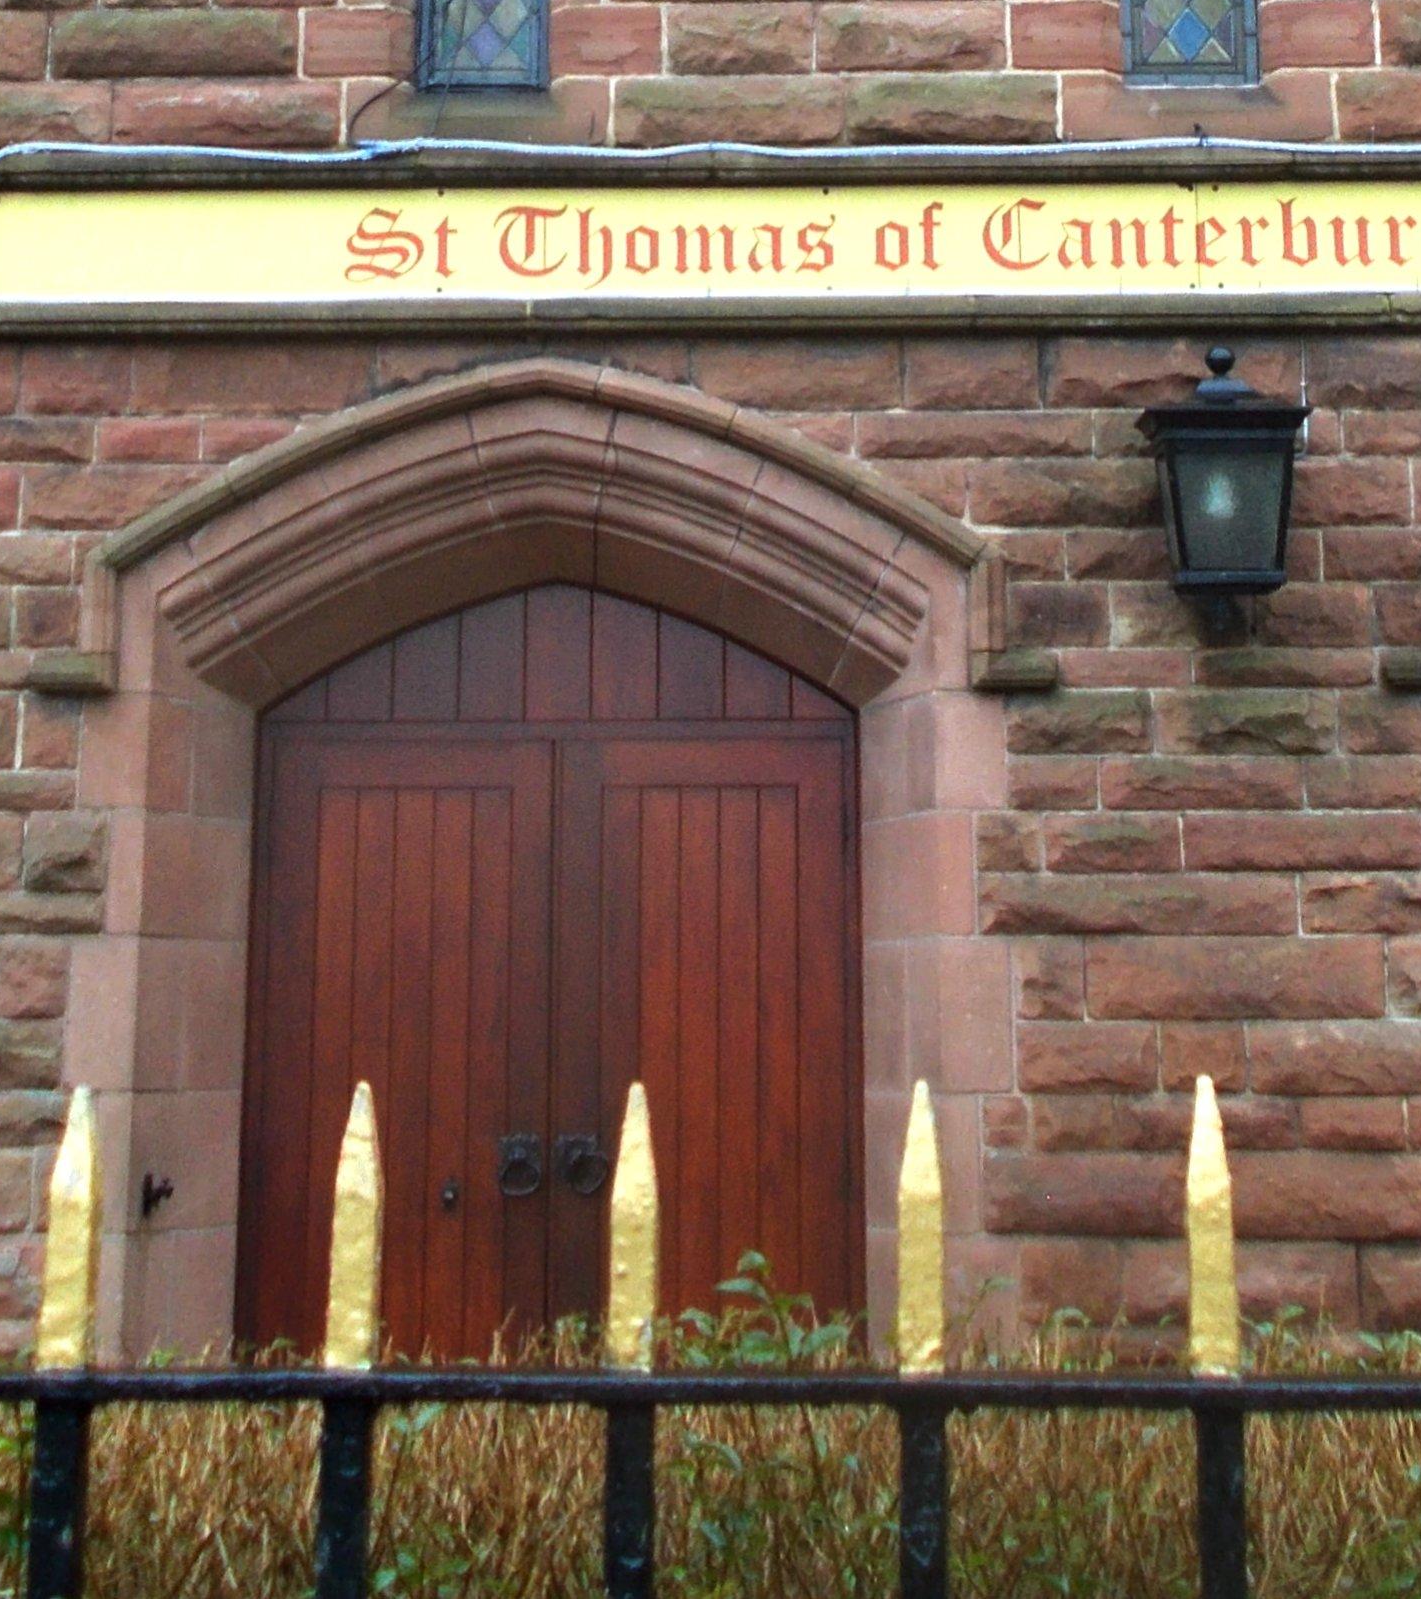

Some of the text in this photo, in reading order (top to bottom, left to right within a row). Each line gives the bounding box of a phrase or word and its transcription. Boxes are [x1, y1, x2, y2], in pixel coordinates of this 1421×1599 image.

[344, 206, 458, 283] St
[493, 204, 835, 290] Thomas
[873, 200, 944, 273] of
